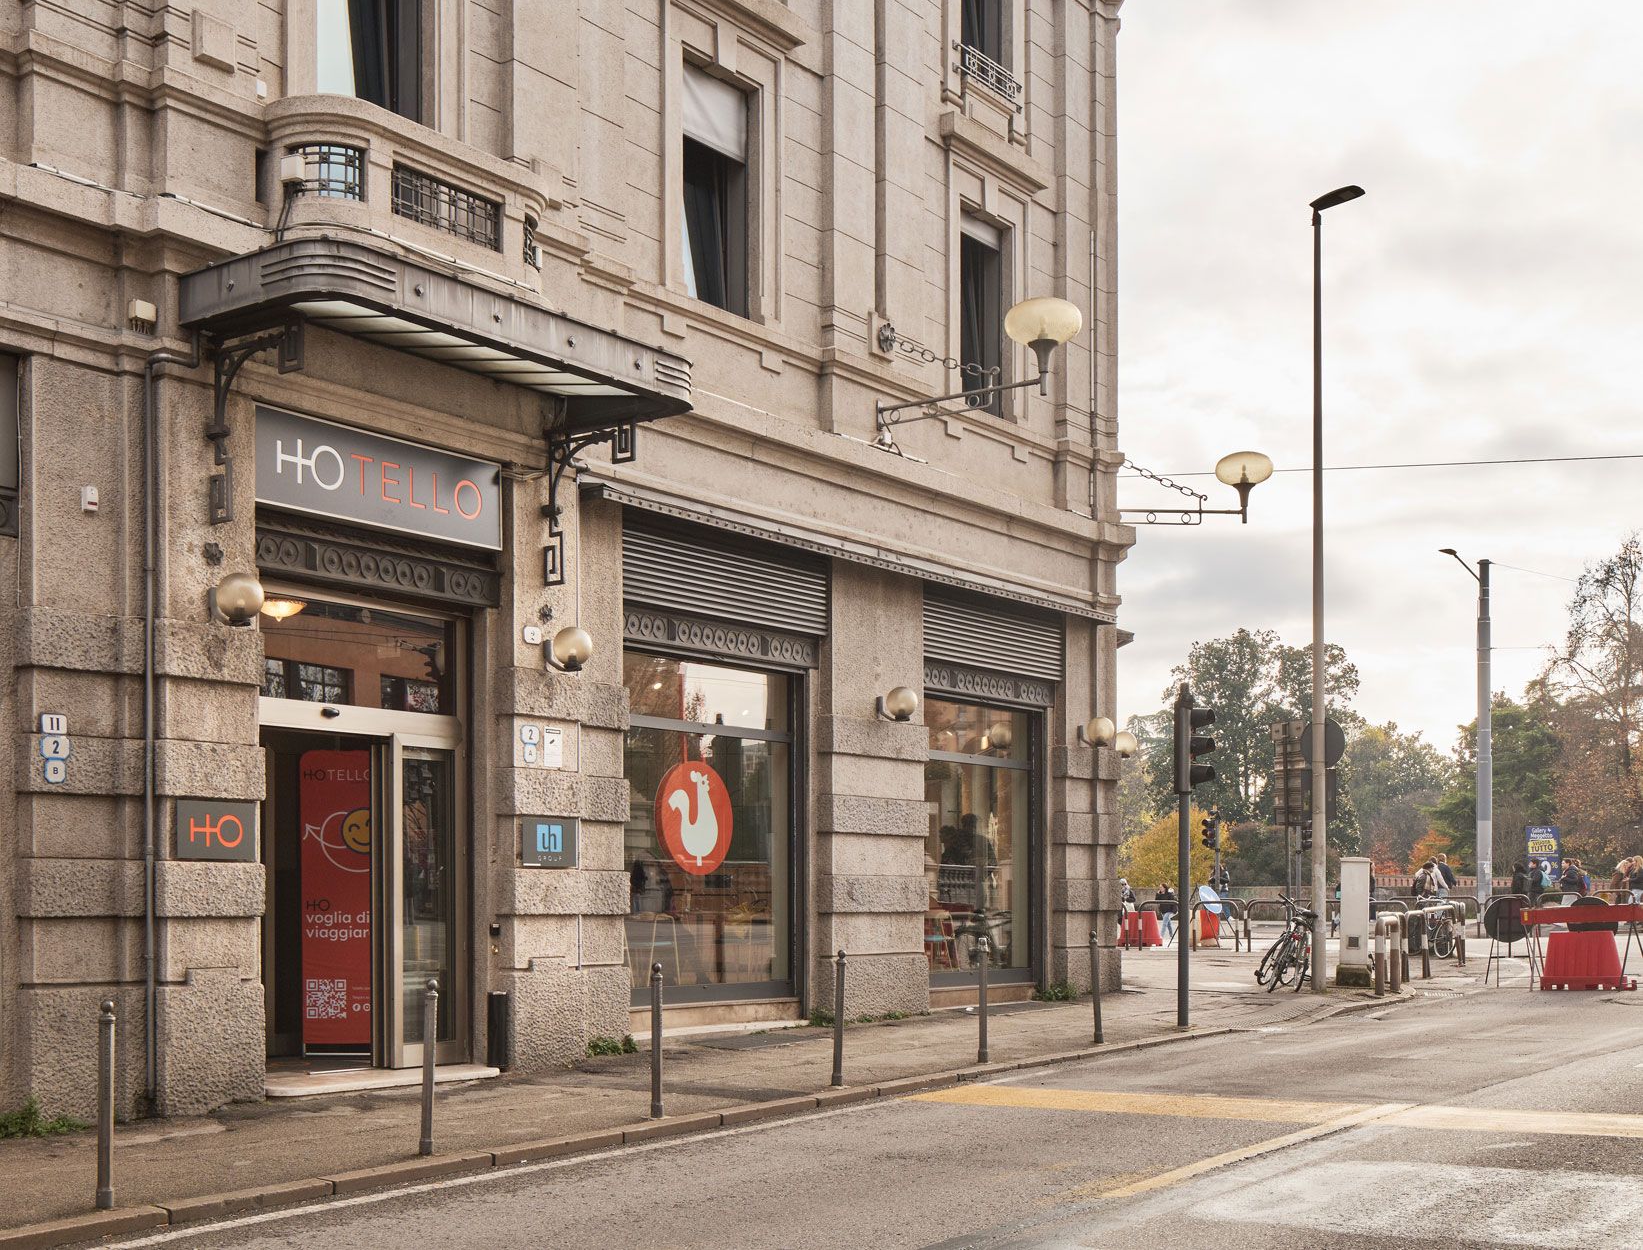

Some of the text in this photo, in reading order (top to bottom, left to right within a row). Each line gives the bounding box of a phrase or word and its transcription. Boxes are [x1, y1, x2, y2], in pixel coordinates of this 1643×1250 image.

[276, 438, 483, 520] HOTELLO
[528, 729, 533, 740] 2
[52, 740, 60, 754] 2
[53, 766, 59, 774] B
[189, 813, 243, 848] HO
[1531, 844, 1553, 852] TUTTO
[306, 899, 330, 911] HO
[306, 911, 370, 926] voglia di
[306, 925, 370, 941] viaggiar
